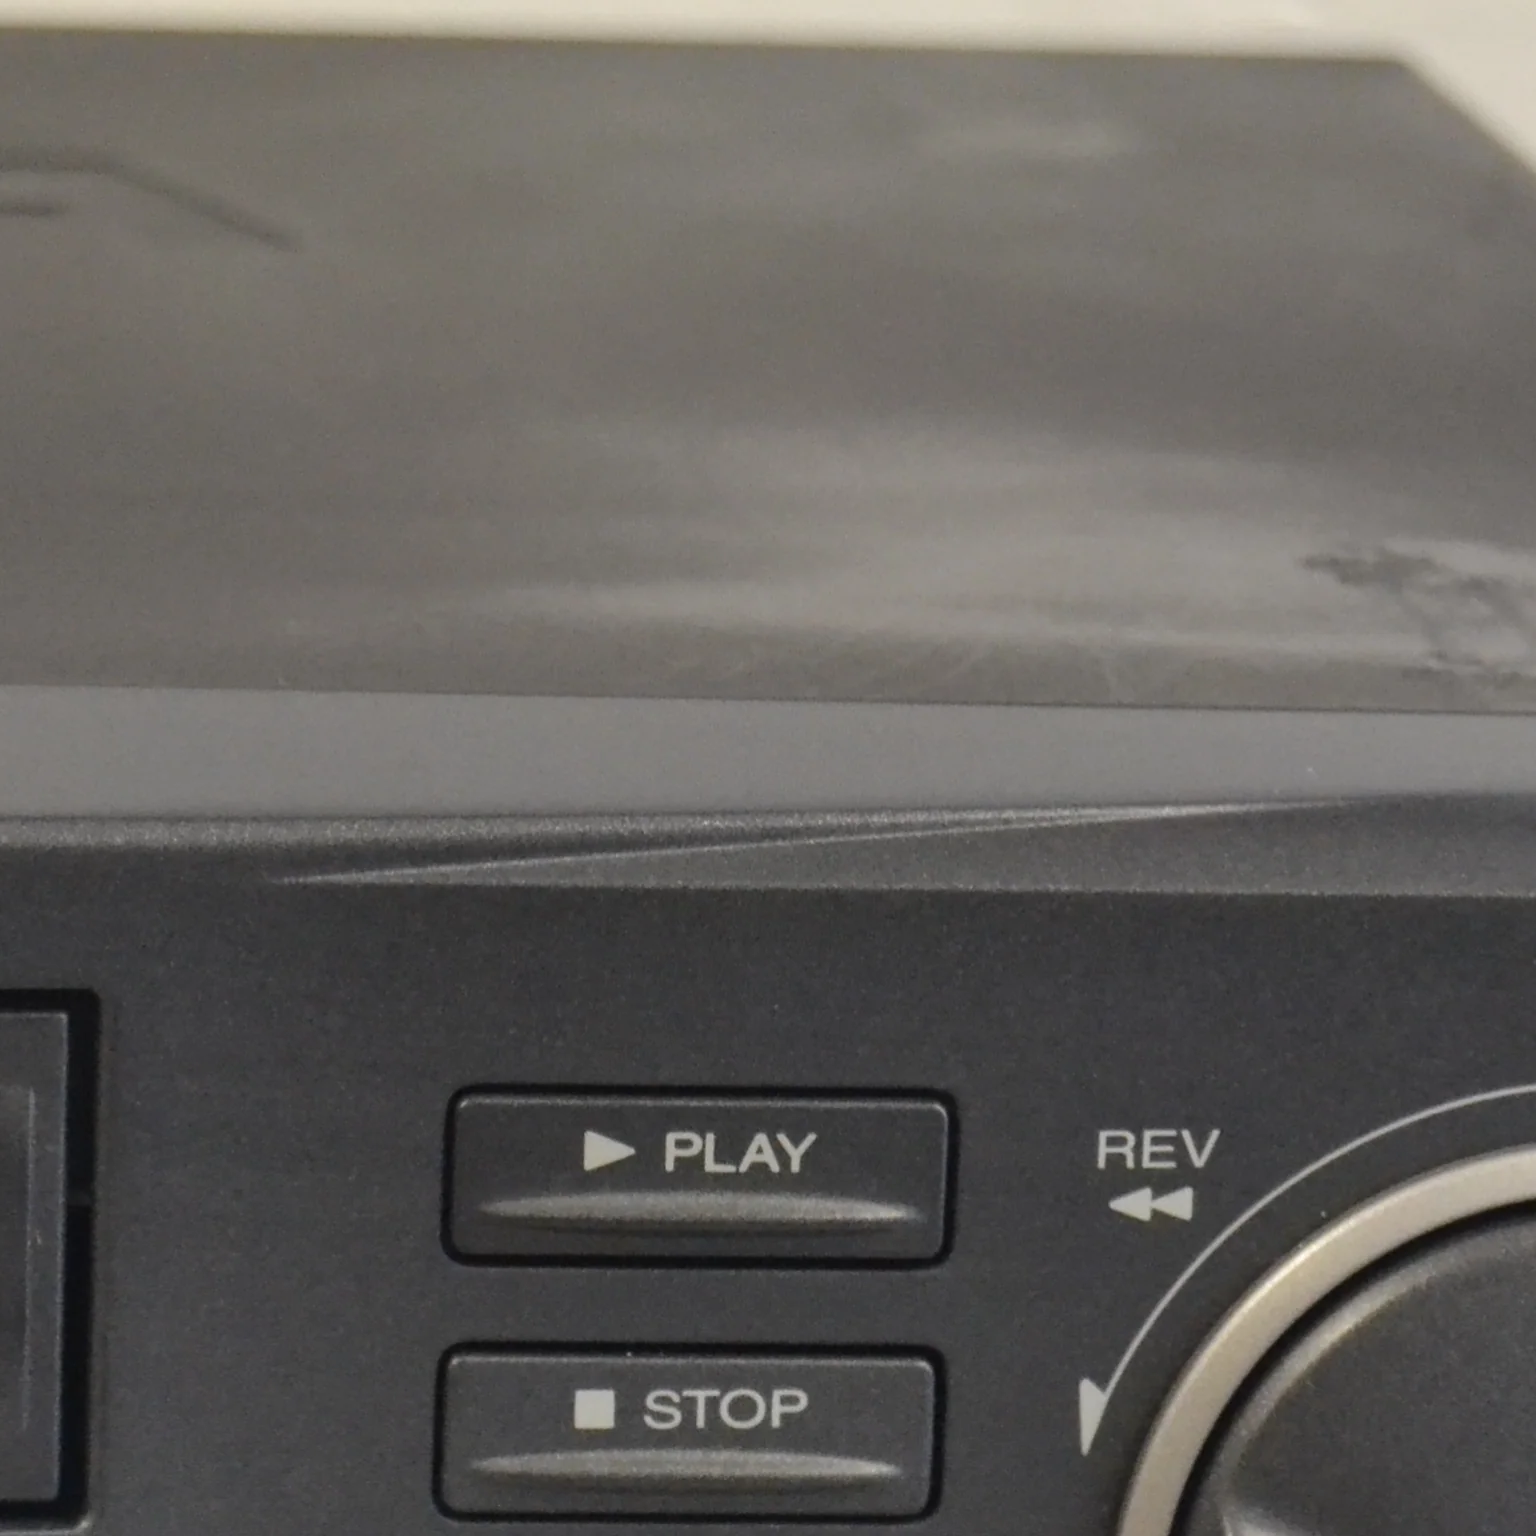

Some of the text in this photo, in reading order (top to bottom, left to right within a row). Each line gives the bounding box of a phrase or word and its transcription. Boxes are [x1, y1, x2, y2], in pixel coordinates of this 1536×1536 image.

[664, 1131, 817, 1174] PLAY
[1097, 1128, 1221, 1170] REV
[643, 1387, 809, 1430] STOP
